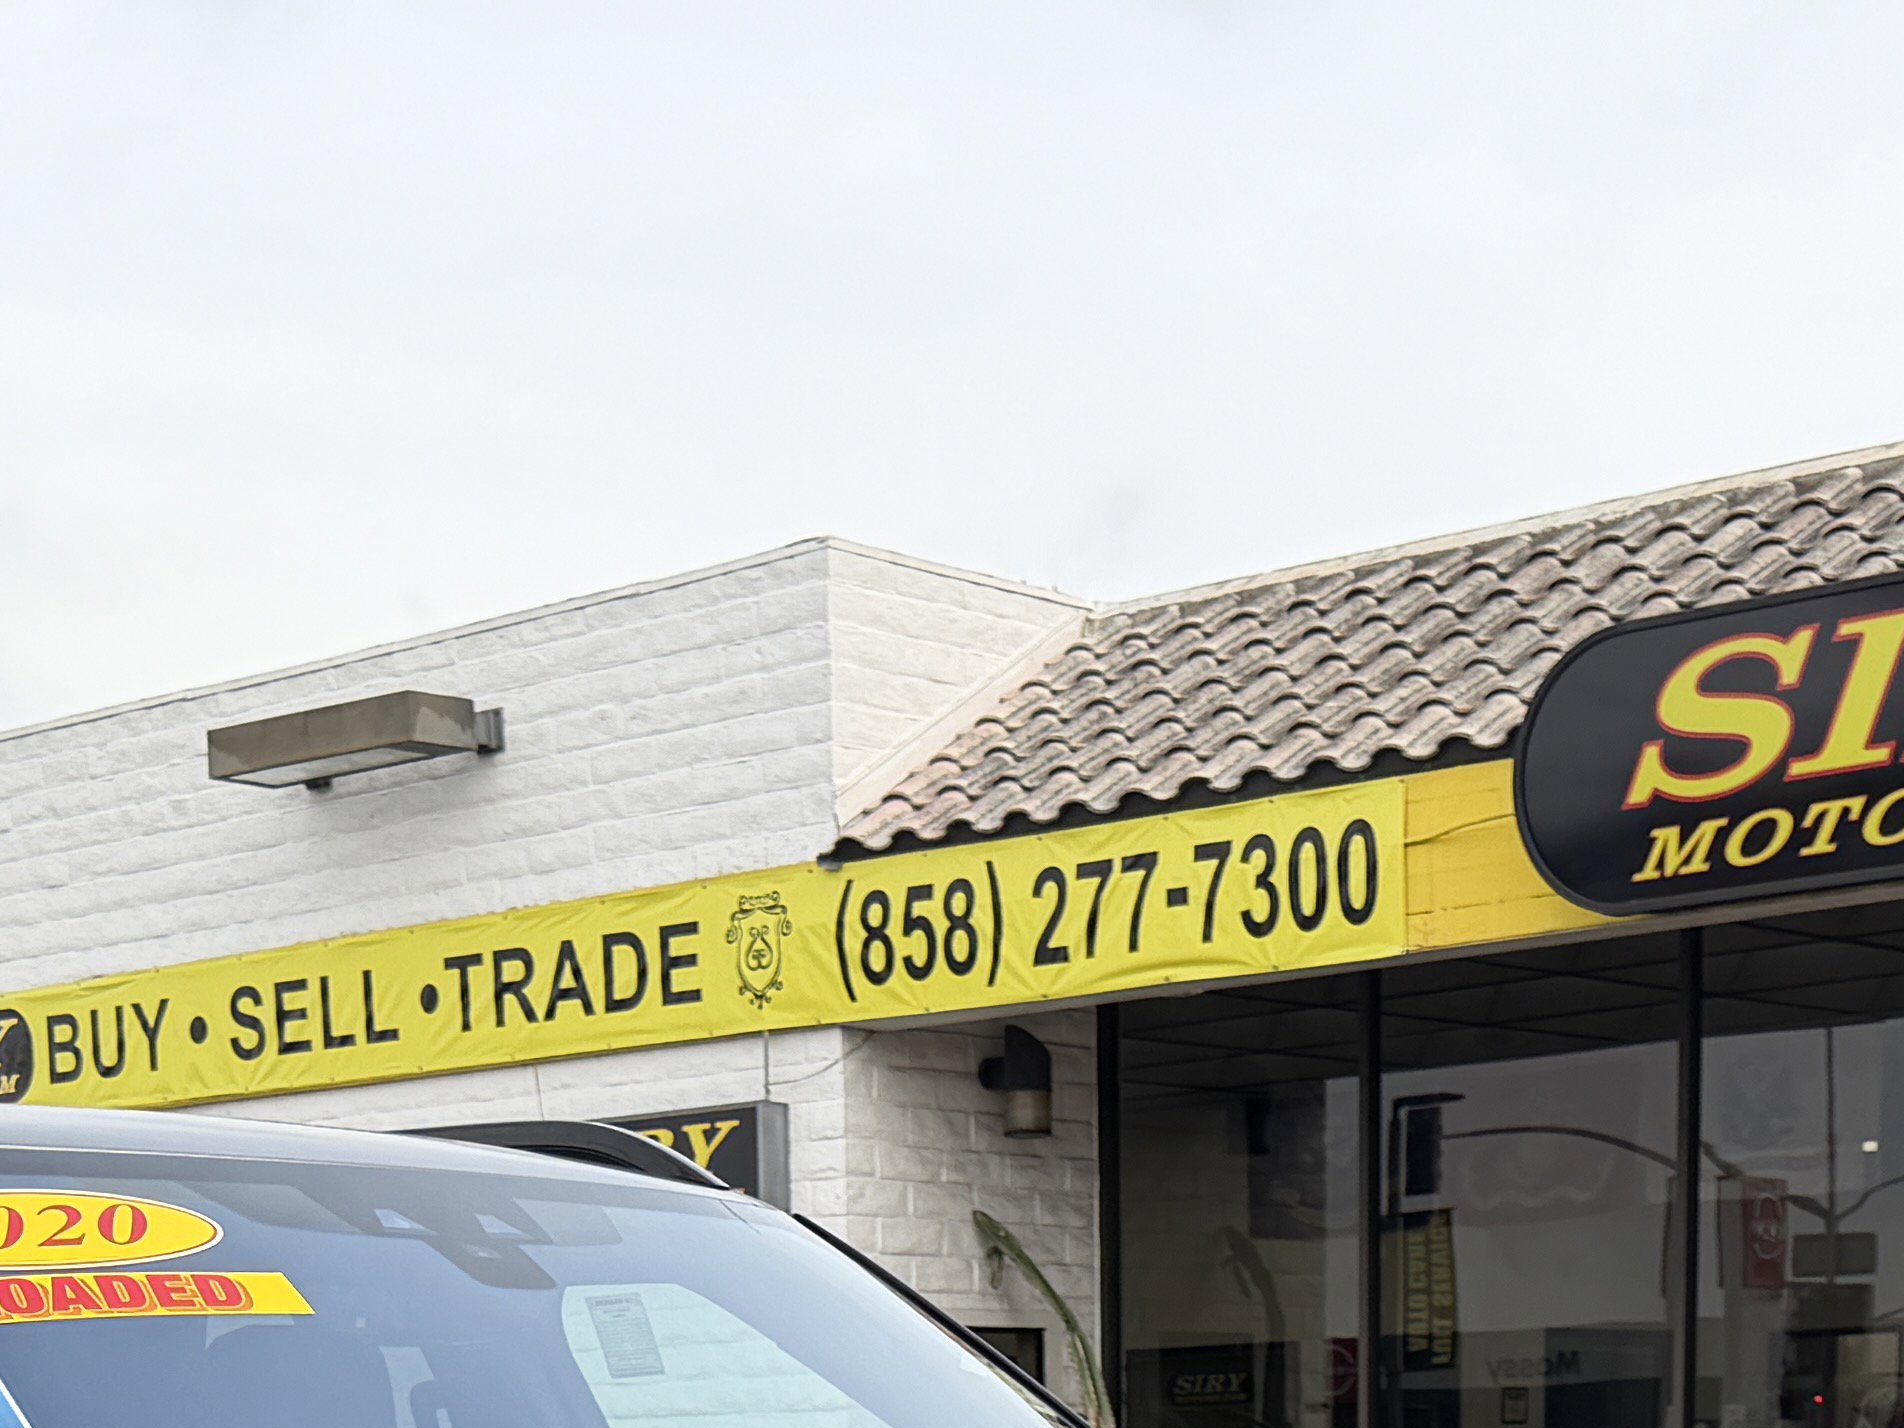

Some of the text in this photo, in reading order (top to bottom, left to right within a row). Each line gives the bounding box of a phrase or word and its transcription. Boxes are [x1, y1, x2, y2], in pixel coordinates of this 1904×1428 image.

[836, 819, 1379, 1003] (858) 277-7300
[47, 922, 703, 1084] BUY SELL TRADE
